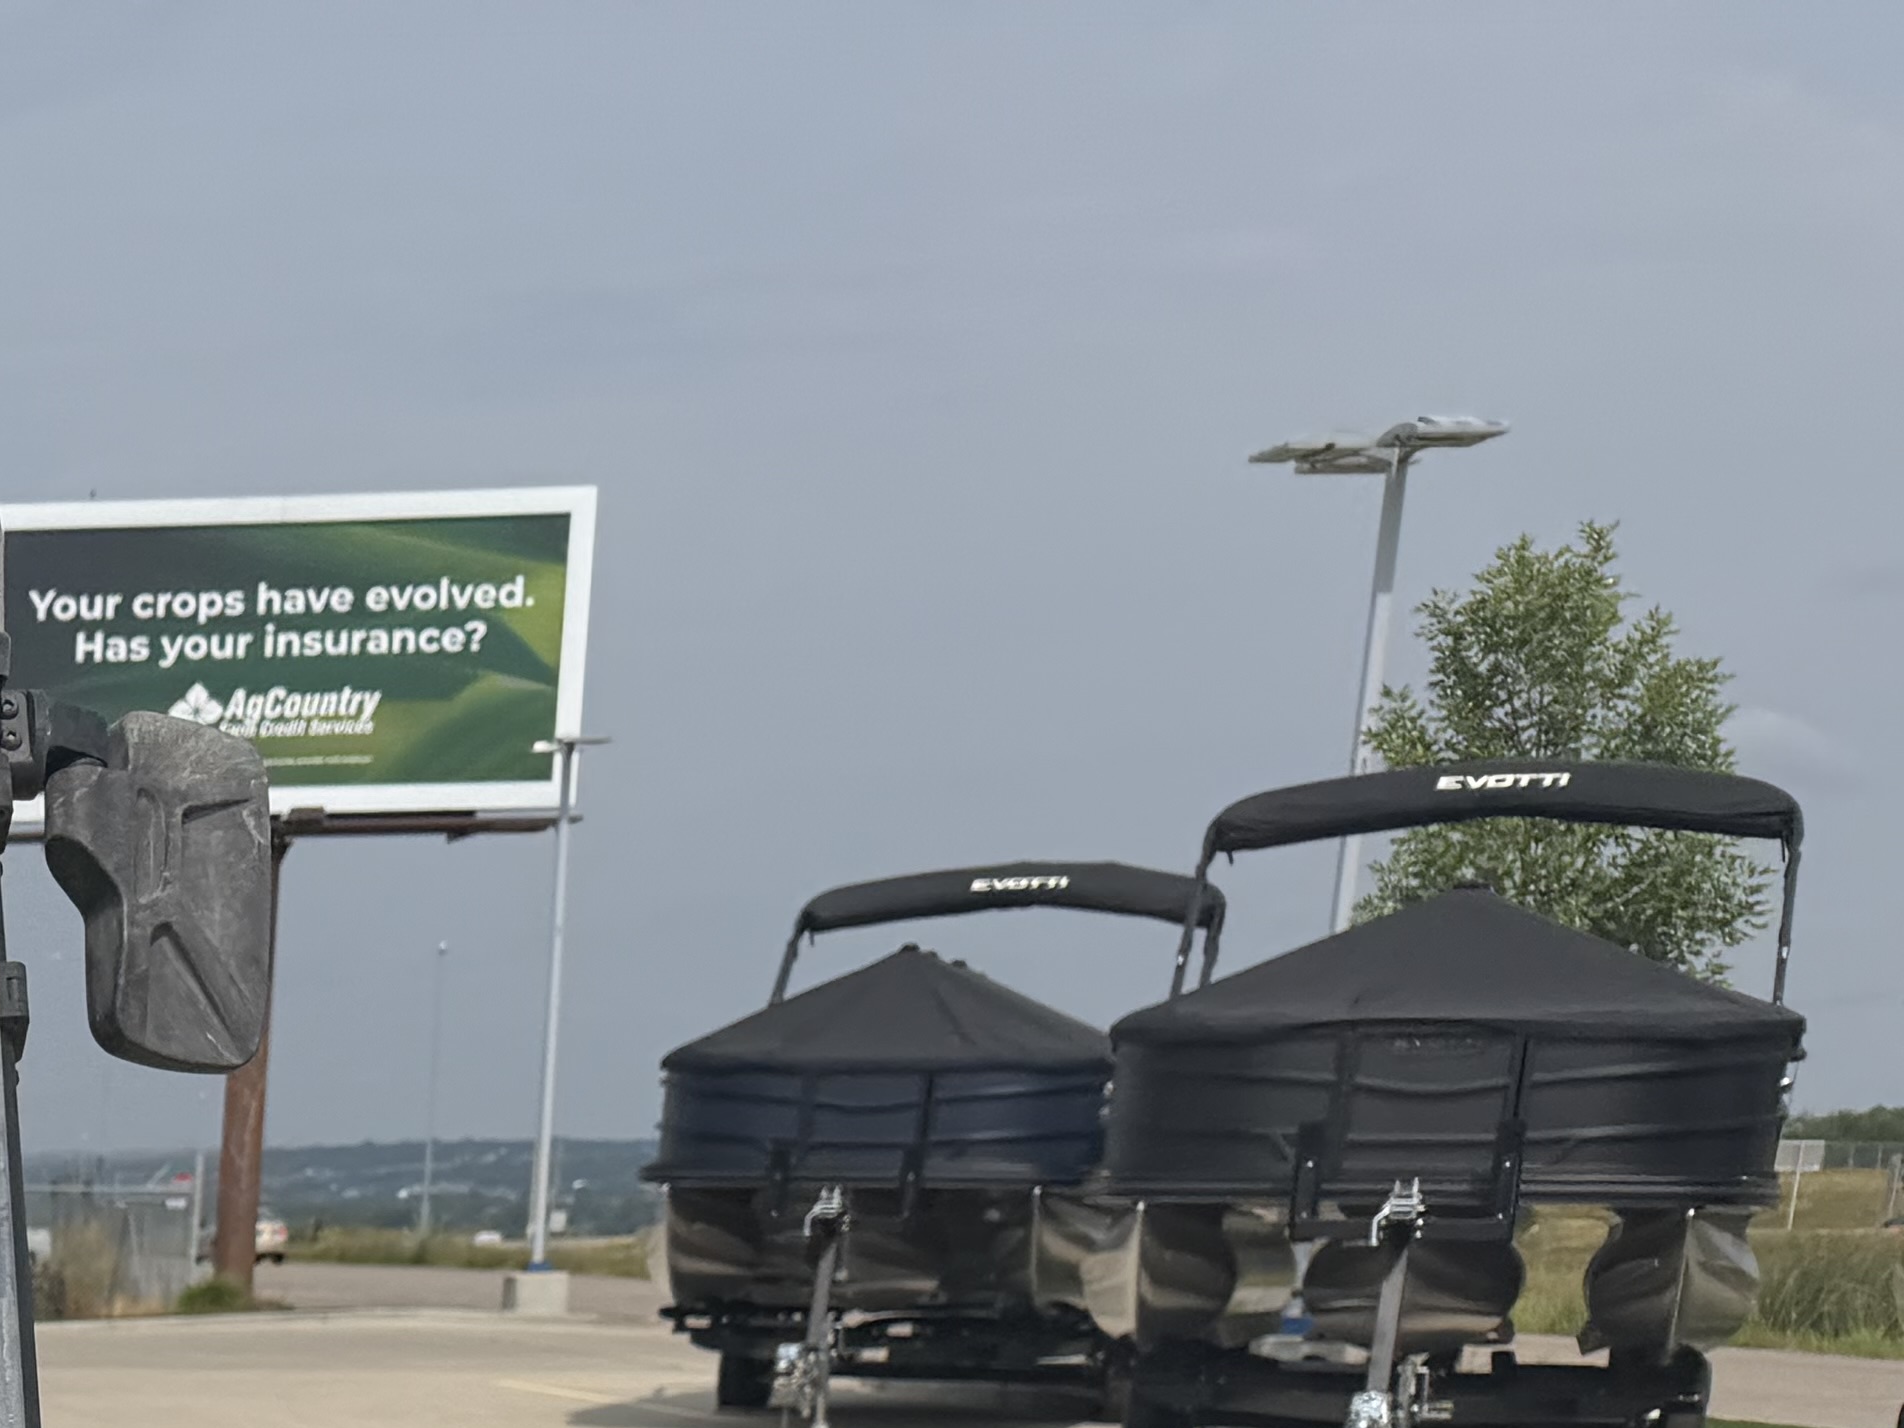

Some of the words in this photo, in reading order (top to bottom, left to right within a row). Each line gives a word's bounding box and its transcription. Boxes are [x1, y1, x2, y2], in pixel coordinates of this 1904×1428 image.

[29, 588, 123, 623] Your
[132, 589, 245, 625] crops
[256, 581, 355, 616] have
[365, 574, 535, 612] evolved.
[75, 629, 151, 664] Has
[158, 632, 254, 669] your
[263, 619, 488, 659] insurance?
[223, 685, 383, 724] AgCountry
[1436, 772, 1572, 791] EVOTTI
[970, 875, 1070, 892] EVOTTI
